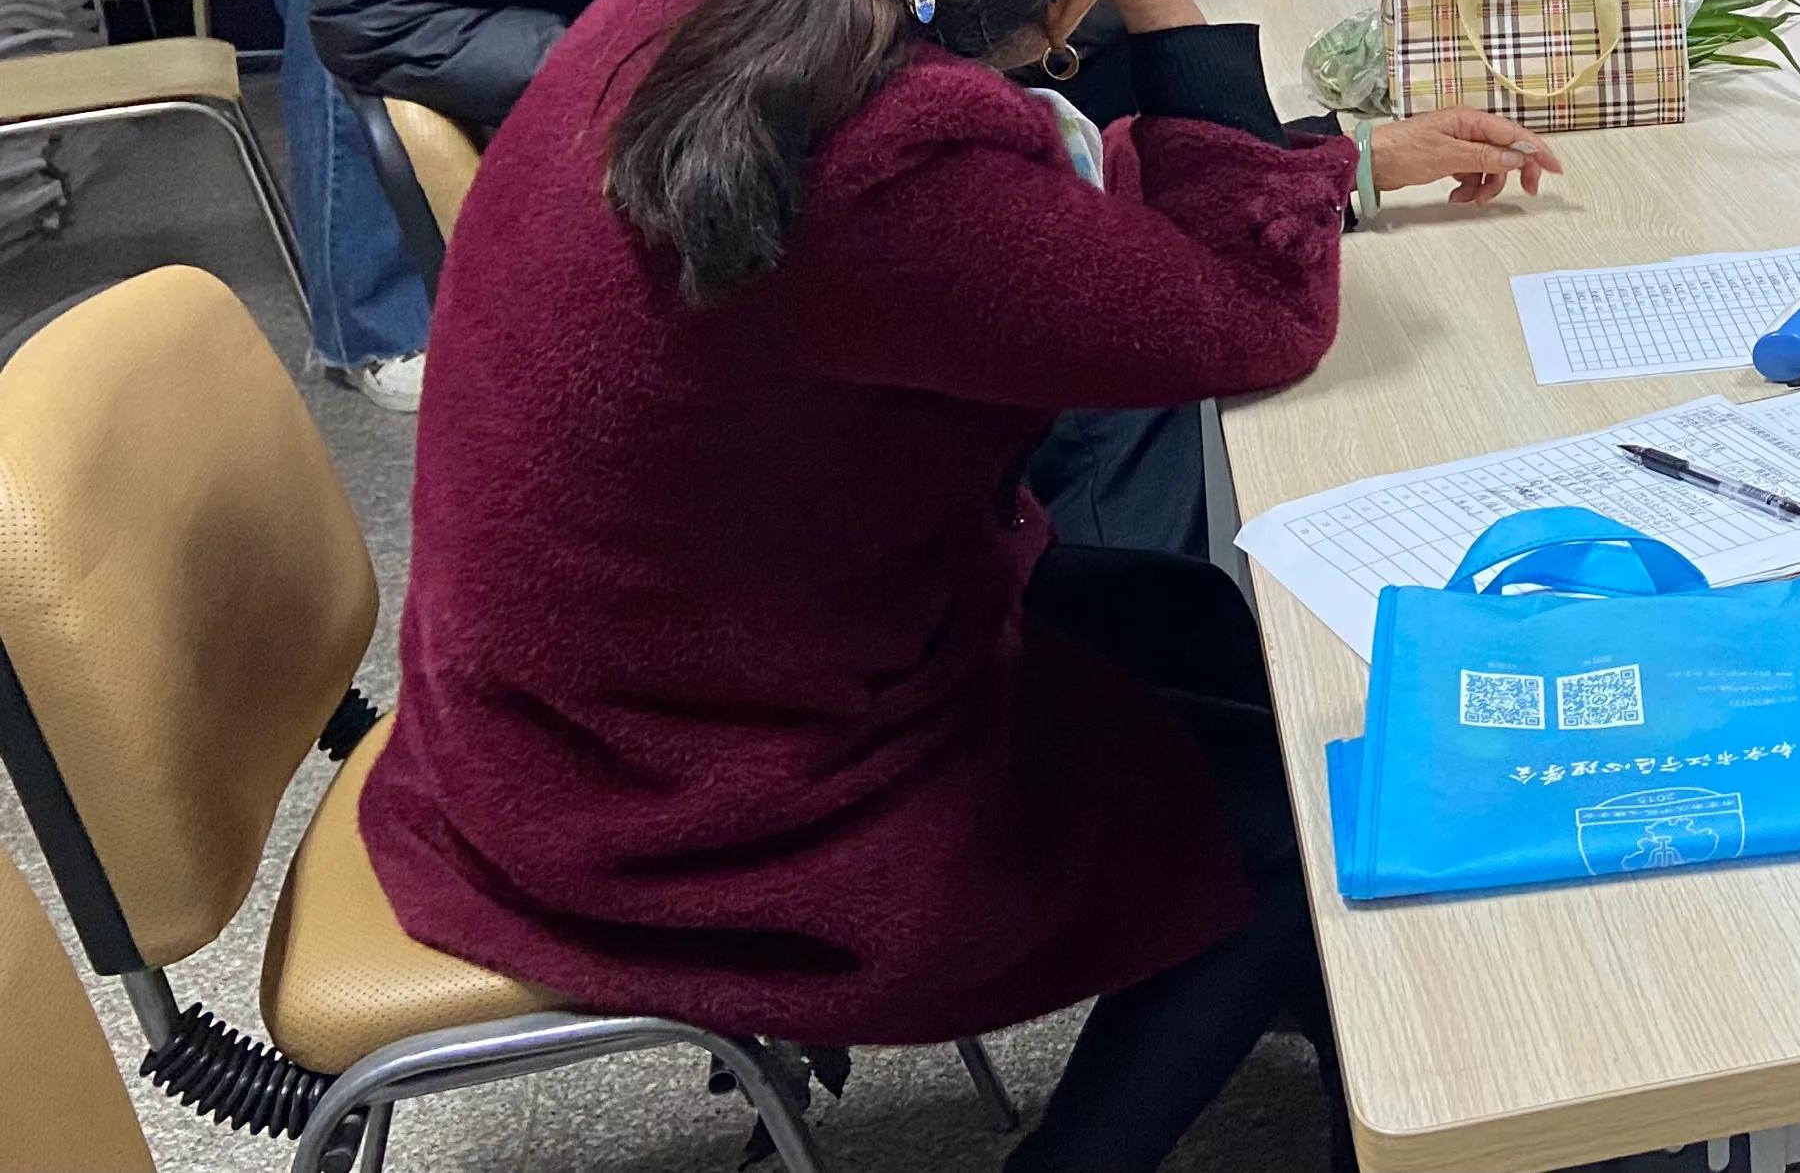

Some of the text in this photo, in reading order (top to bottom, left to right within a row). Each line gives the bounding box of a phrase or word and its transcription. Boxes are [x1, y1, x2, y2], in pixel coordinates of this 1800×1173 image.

[1509, 740, 1797, 786] 南京市江宁区心理学会
[1637, 791, 1677, 805] 2015
